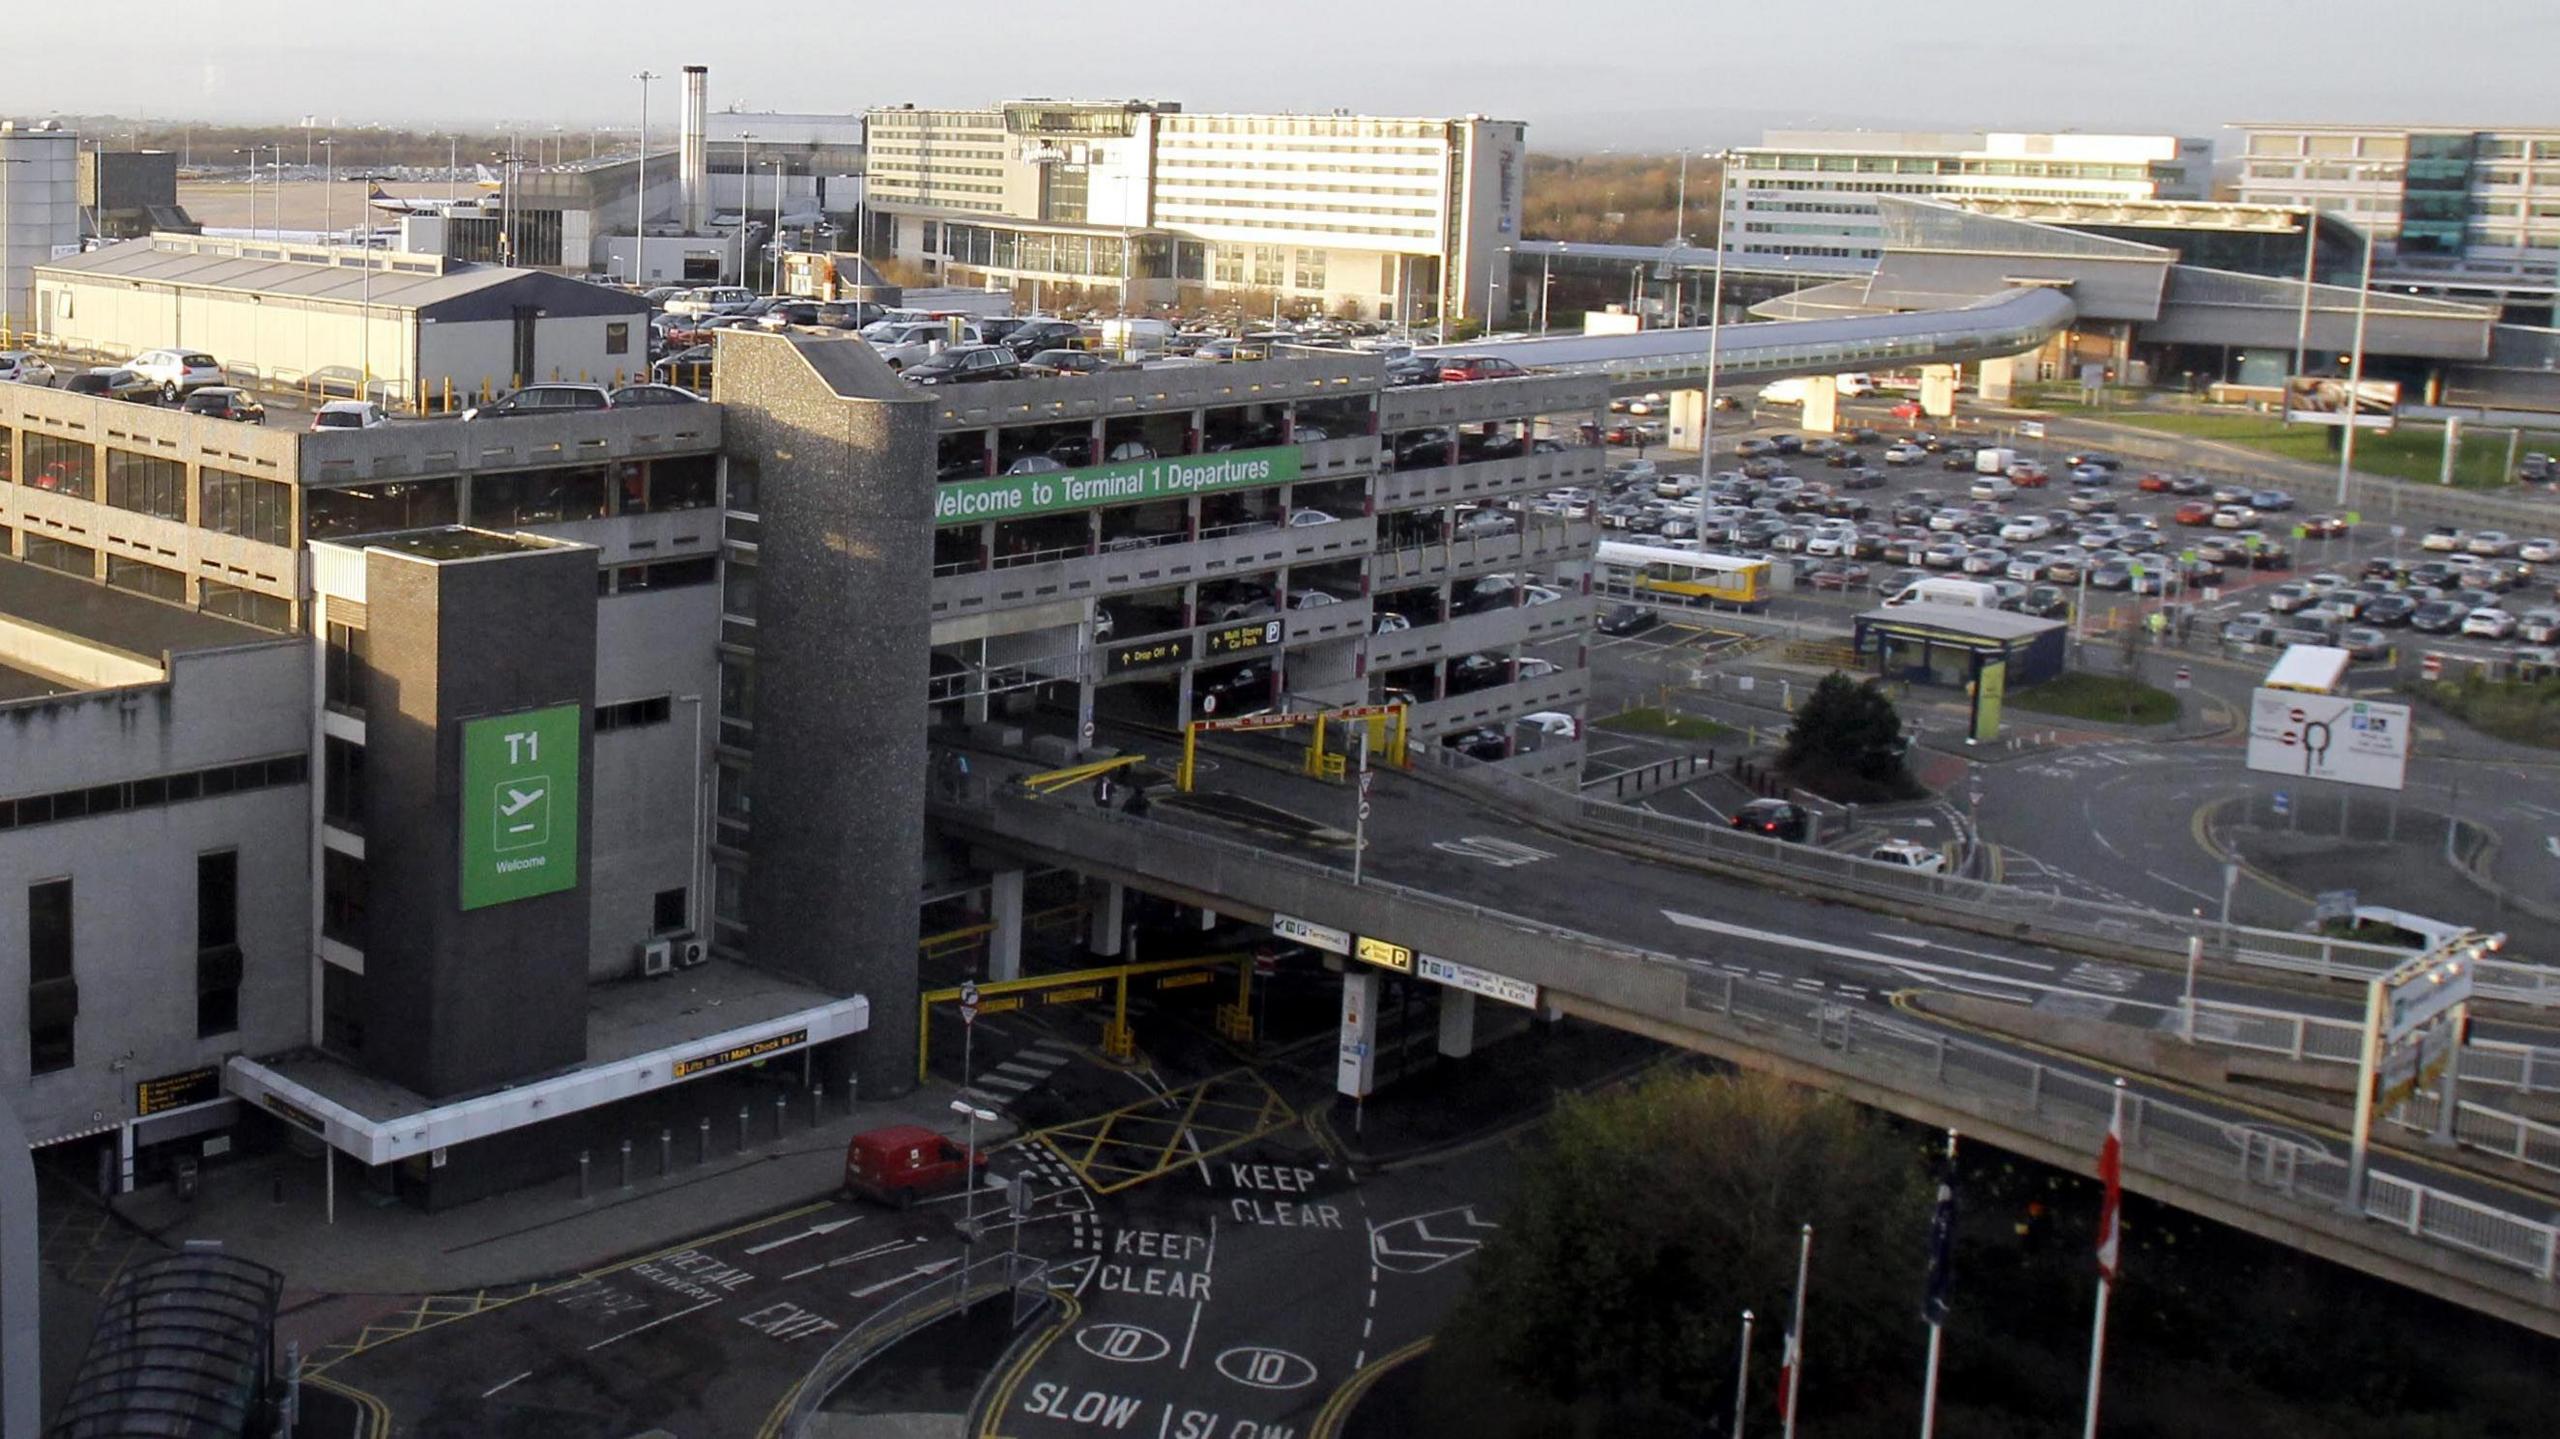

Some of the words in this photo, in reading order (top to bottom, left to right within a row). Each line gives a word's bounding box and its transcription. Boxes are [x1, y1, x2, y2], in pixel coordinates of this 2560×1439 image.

[1032, 482, 1053, 505] to
[1061, 470, 1144, 500] Terminal
[1152, 469, 1161, 490] 1
[1168, 458, 1270, 492] Departures
[504, 731, 538, 764] T1
[496, 855, 546, 873] Welcome
[1394, 949, 1406, 965] P
[730, 1047, 751, 1061] Main
[753, 1040, 778, 1054] Check
[1230, 1162, 1316, 1193] KEEP
[1231, 1199, 1343, 1230] CLEAR
[1114, 1229, 1206, 1260] KEEP
[1099, 1264, 1212, 1301] CLEAR
[1103, 1326, 1142, 1357] 10
[1246, 1351, 1285, 1384] 10
[1024, 1382, 1142, 1430] SLOW
